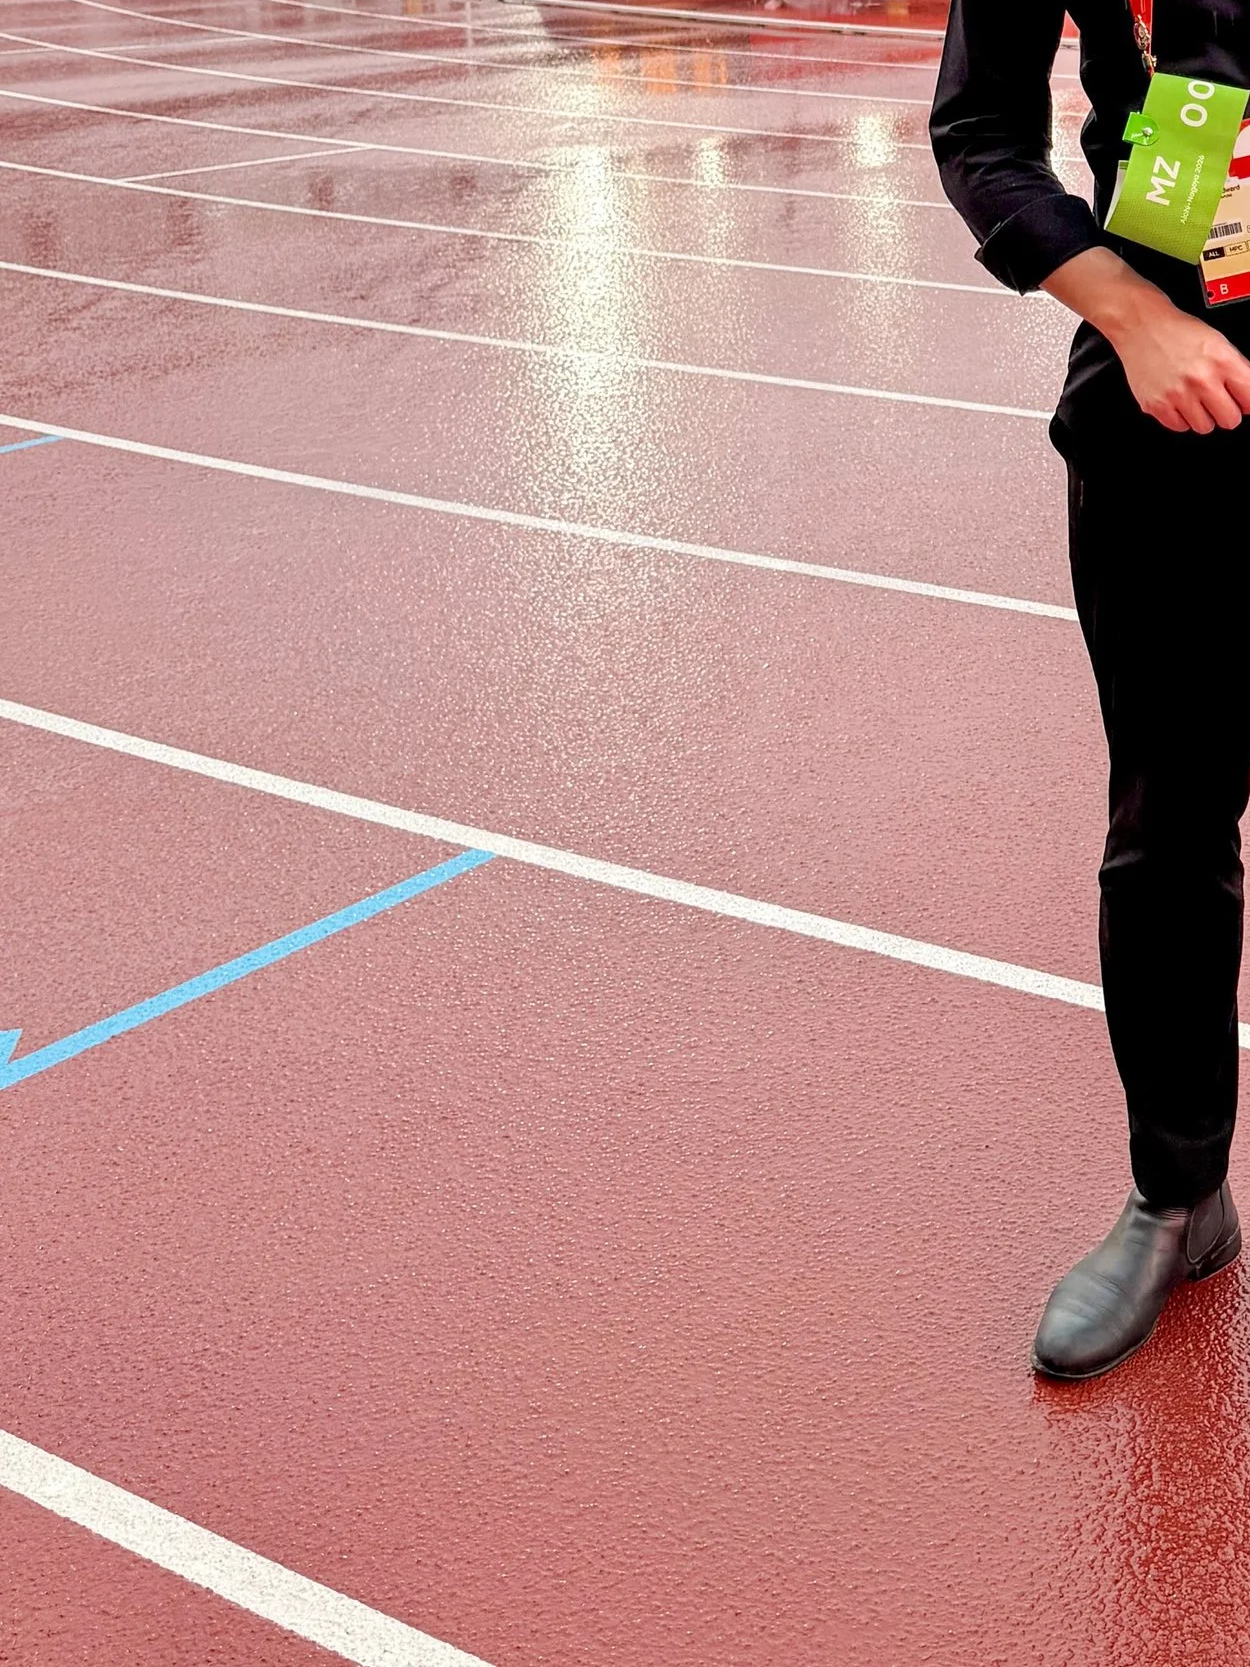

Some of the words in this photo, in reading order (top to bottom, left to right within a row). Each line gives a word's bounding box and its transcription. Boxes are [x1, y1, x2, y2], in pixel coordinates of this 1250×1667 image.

[1194, 154, 1205, 174] 2026
[1145, 155, 1181, 206] MZ
[1208, 250, 1219, 258] ALL
[1219, 283, 1229, 295] B
